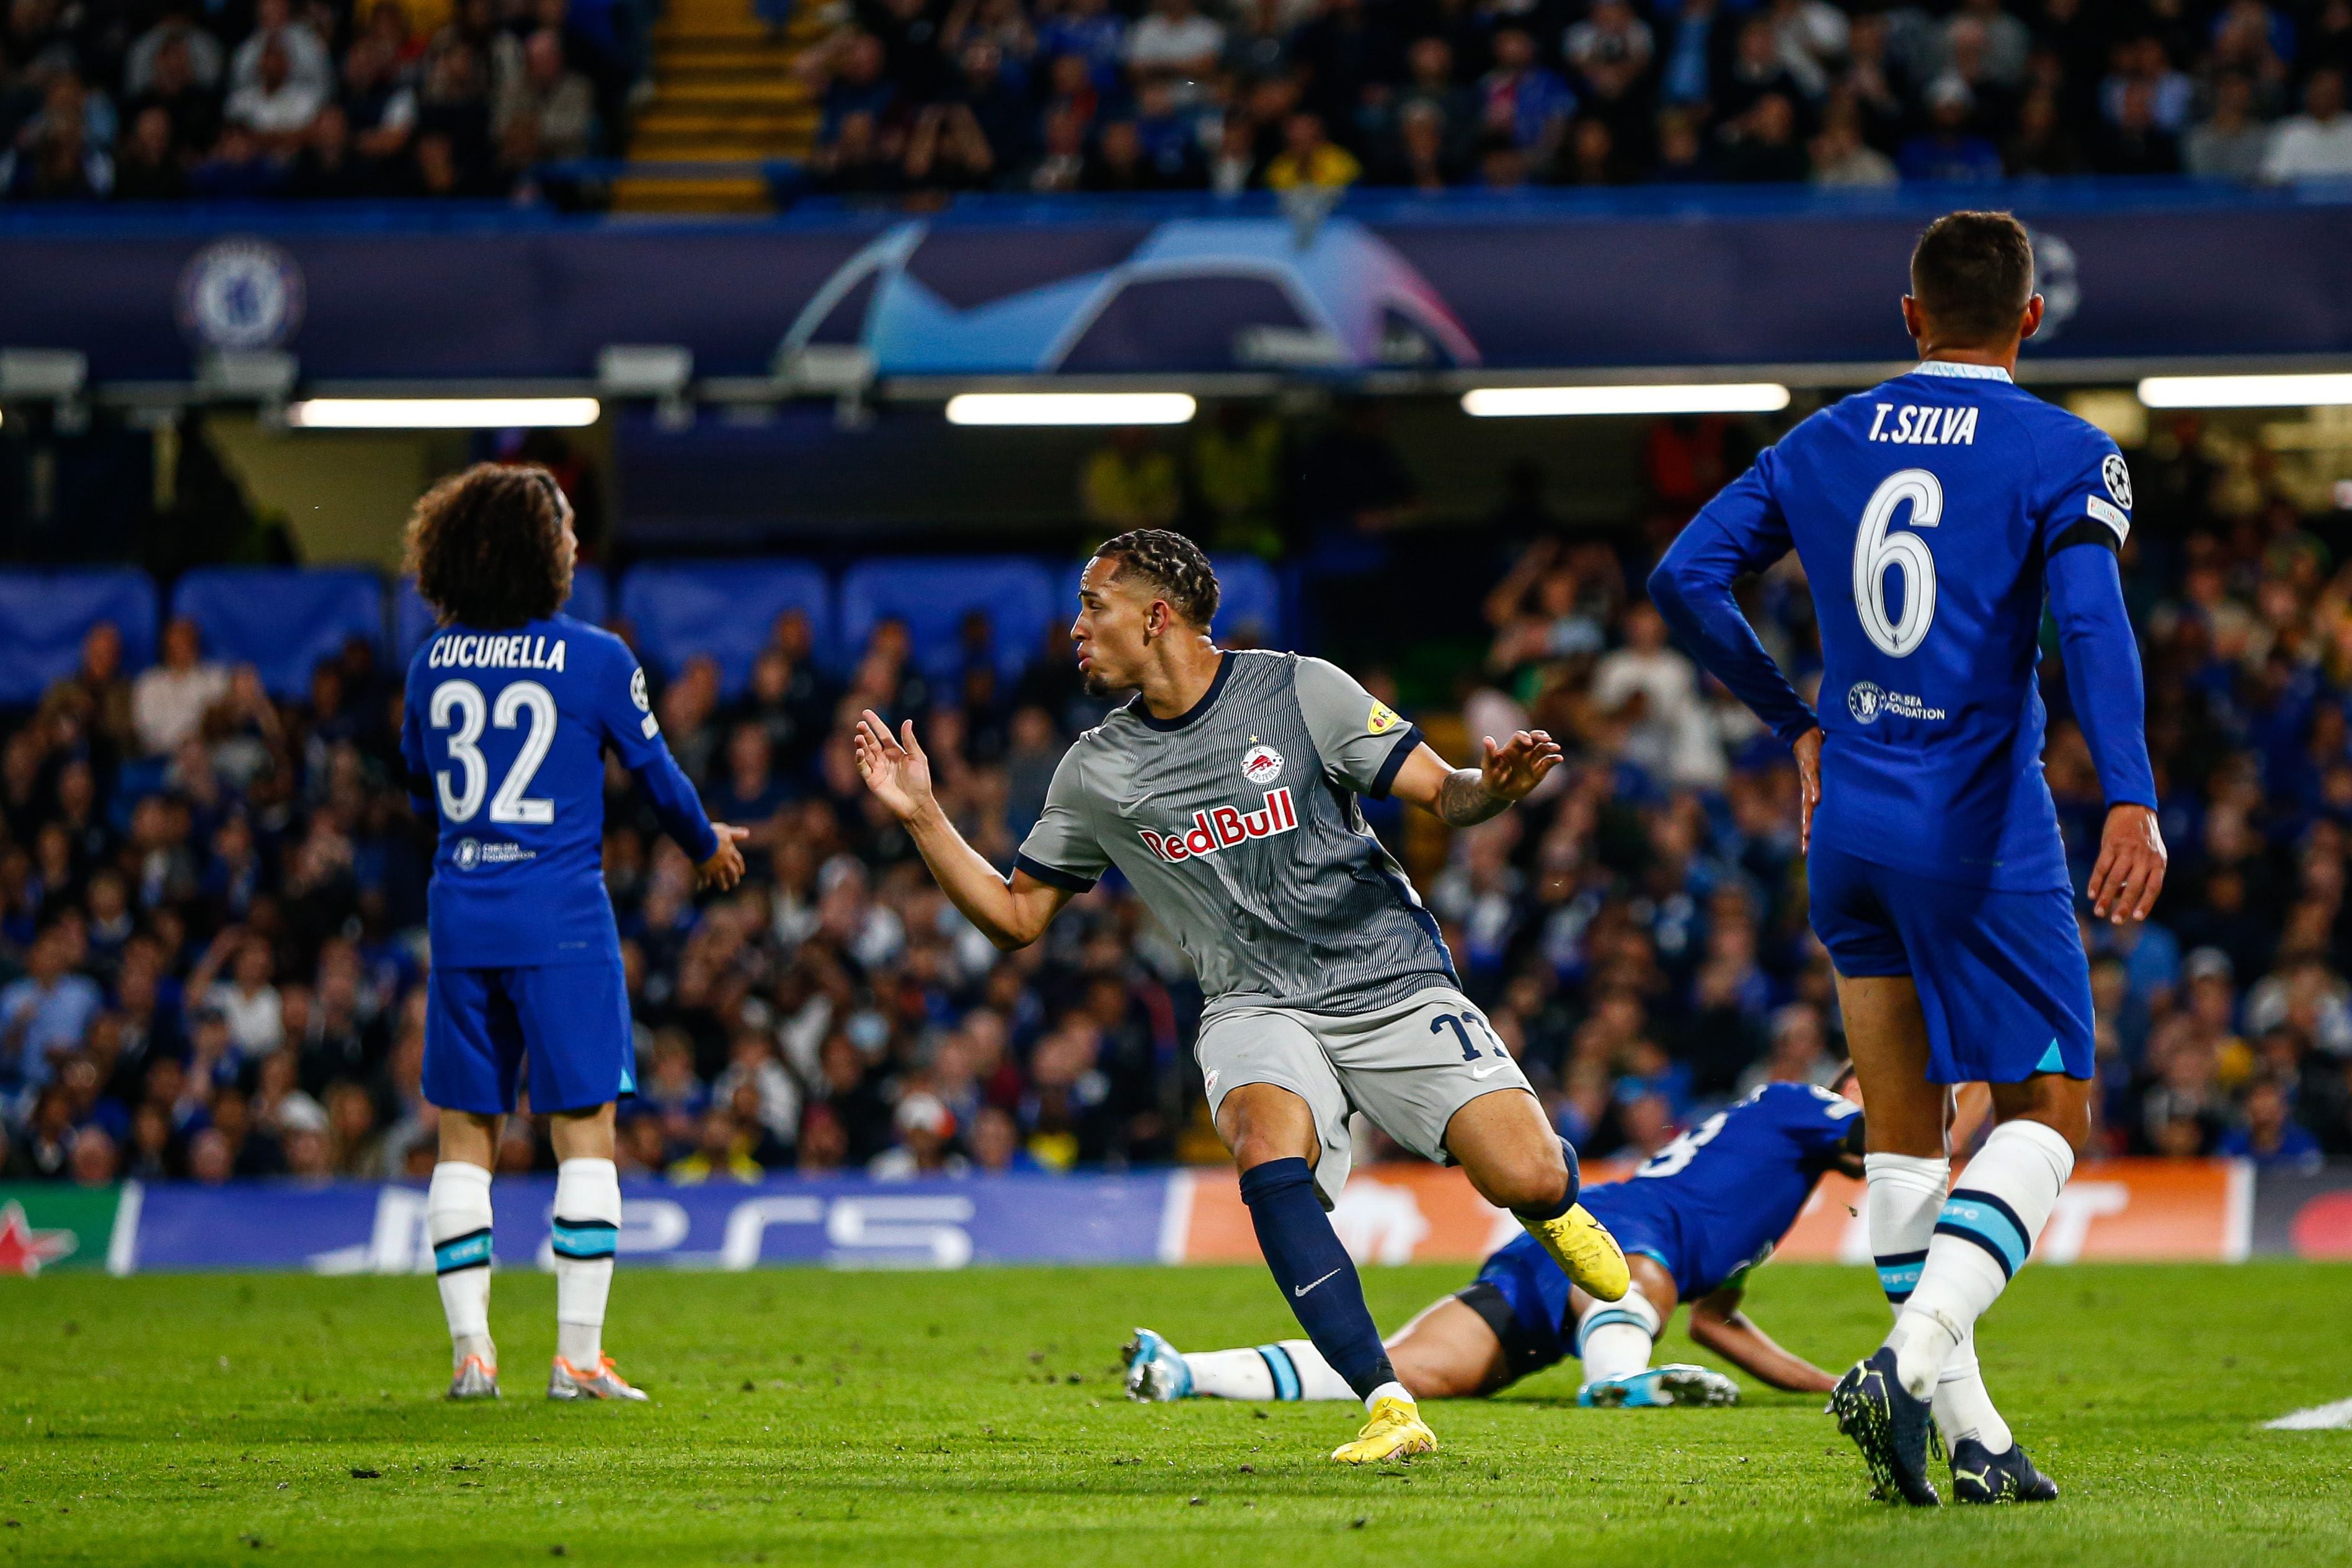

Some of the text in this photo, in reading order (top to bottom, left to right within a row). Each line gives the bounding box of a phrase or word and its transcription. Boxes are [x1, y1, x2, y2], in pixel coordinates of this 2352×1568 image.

[1869, 402, 1979, 445] T.SILVA
[1853, 467, 1943, 658] 6
[428, 634, 567, 673] CUCURELLA
[1885, 702, 1946, 721] FOUDATION
[1889, 691, 1922, 707] CHSEA
[428, 678, 558, 825] 32
[1254, 747, 1263, 755] FC
[1430, 1011, 1509, 1061] 77
